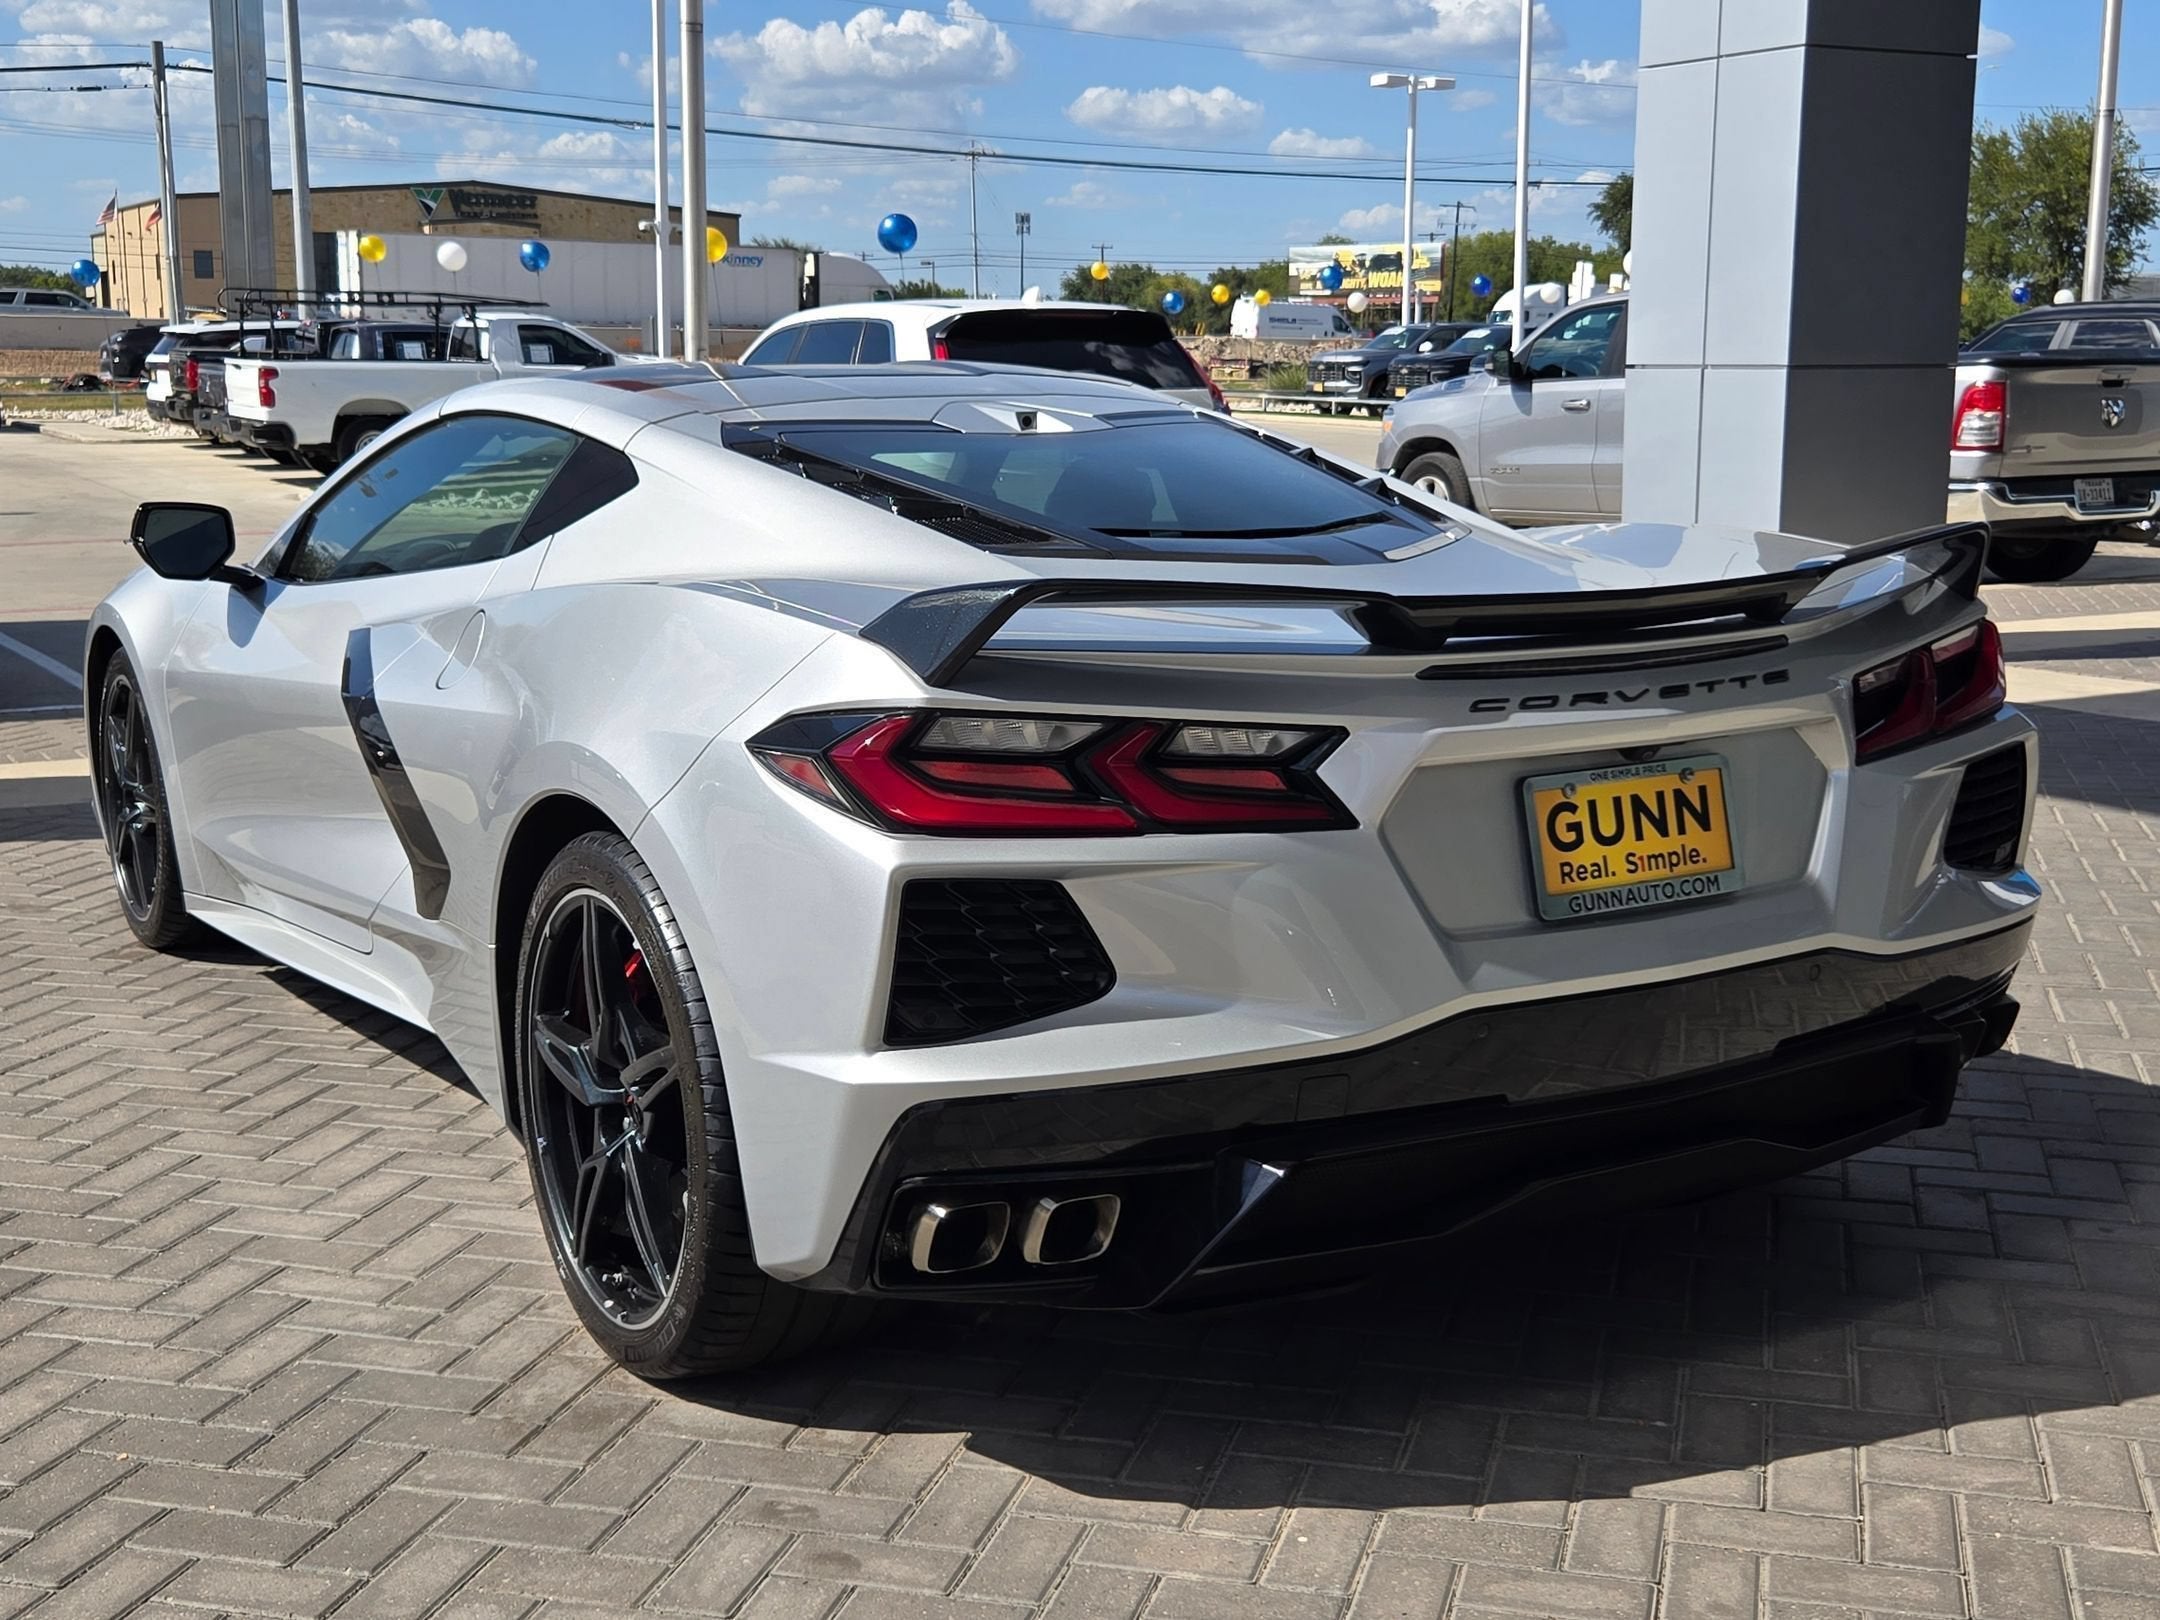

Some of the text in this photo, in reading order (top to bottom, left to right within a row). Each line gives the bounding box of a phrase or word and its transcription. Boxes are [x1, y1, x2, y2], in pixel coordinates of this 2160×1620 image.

[1468, 669, 1790, 713] CORVETTE
[1590, 764, 1667, 782] ONE SIMPLE PRICE
[1546, 785, 1711, 853] GUNN
[1559, 855, 1616, 885] Real.
[1569, 874, 1721, 913] GUNNAUTO.COM
